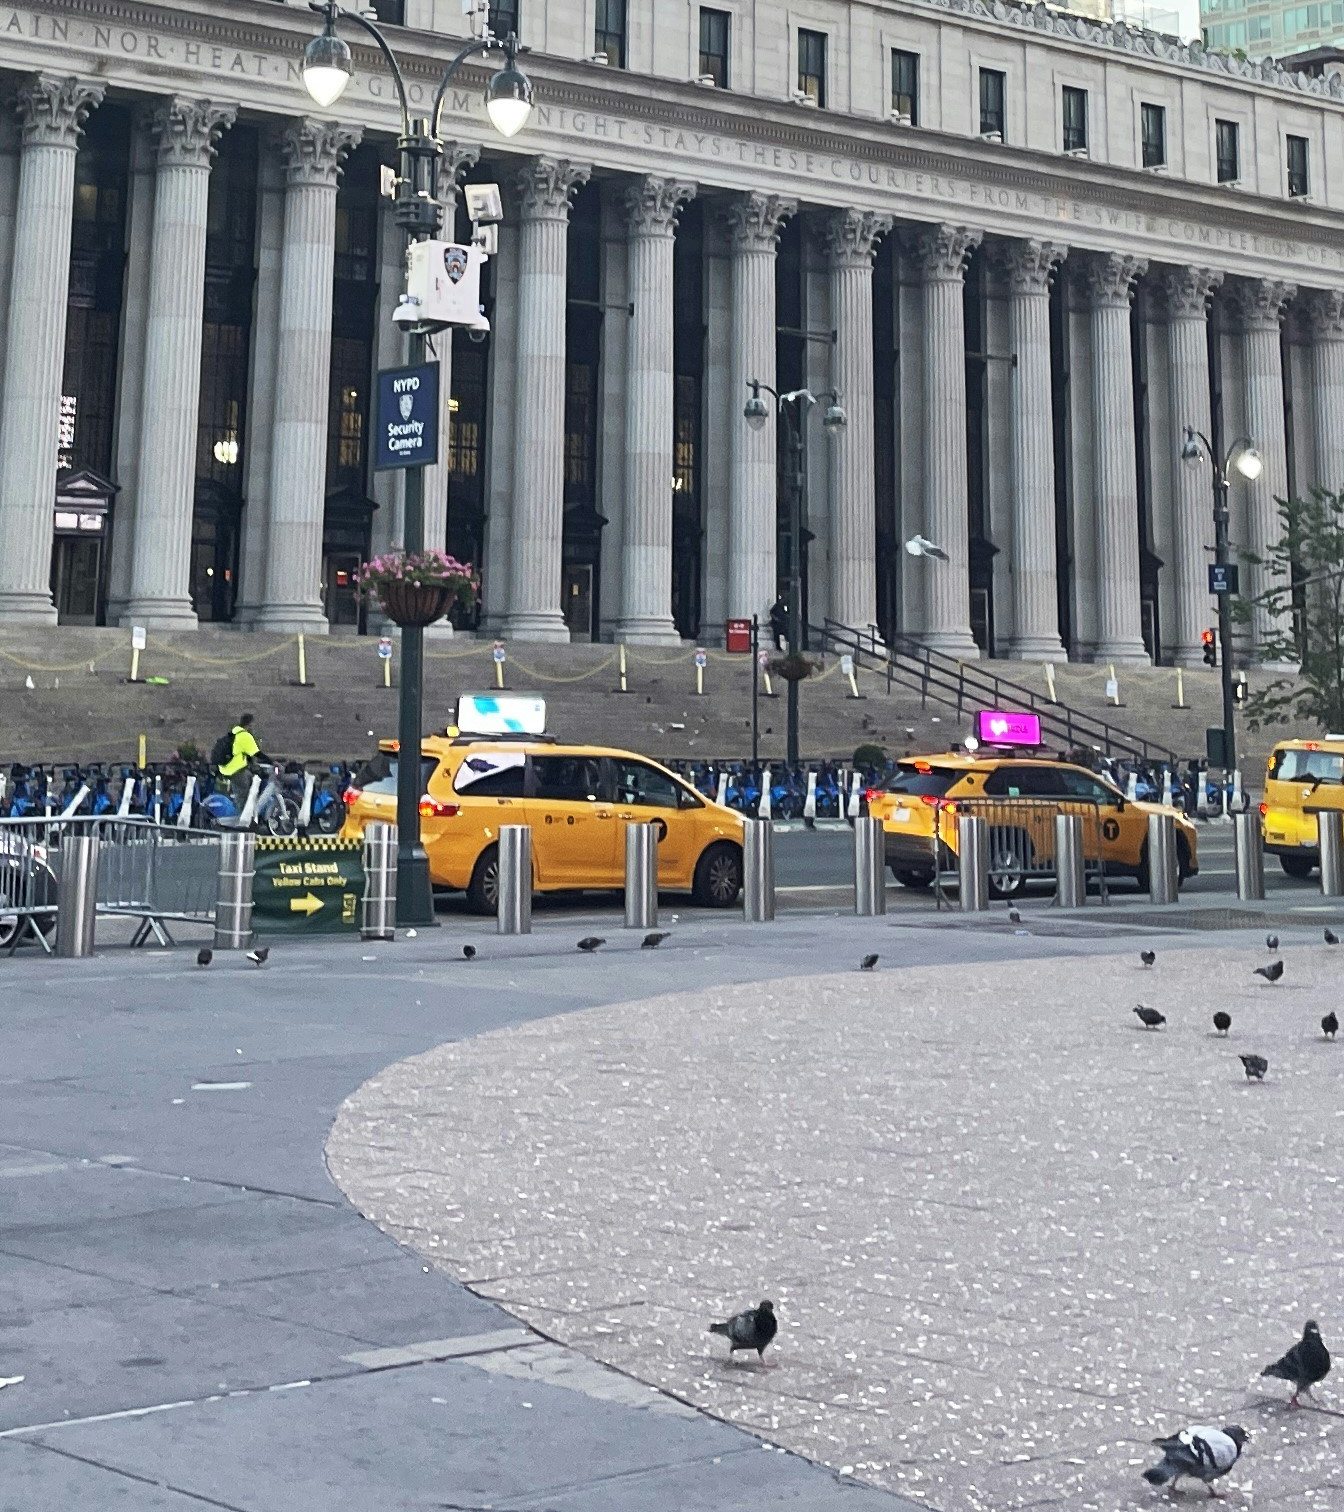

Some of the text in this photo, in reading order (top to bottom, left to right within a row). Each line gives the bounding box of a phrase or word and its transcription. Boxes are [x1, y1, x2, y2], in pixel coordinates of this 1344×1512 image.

[94, 25, 164, 58] NOR
[184, 41, 268, 76] HEAT
[537, 108, 627, 140] NIGHT
[642, 125, 722, 156] STAYS
[735, 140, 816, 173] THESE
[830, 159, 955, 199] COURIERS
[969, 184, 1029, 211] FROM
[1041, 197, 1080, 220] THE
[1094, 209, 1154, 232] SWIF
[393, 377, 420, 393] NYPD
[387, 420, 424, 437] Security
[388, 437, 423, 451] Camera
[279, 861, 339, 874] Taxi Stand
